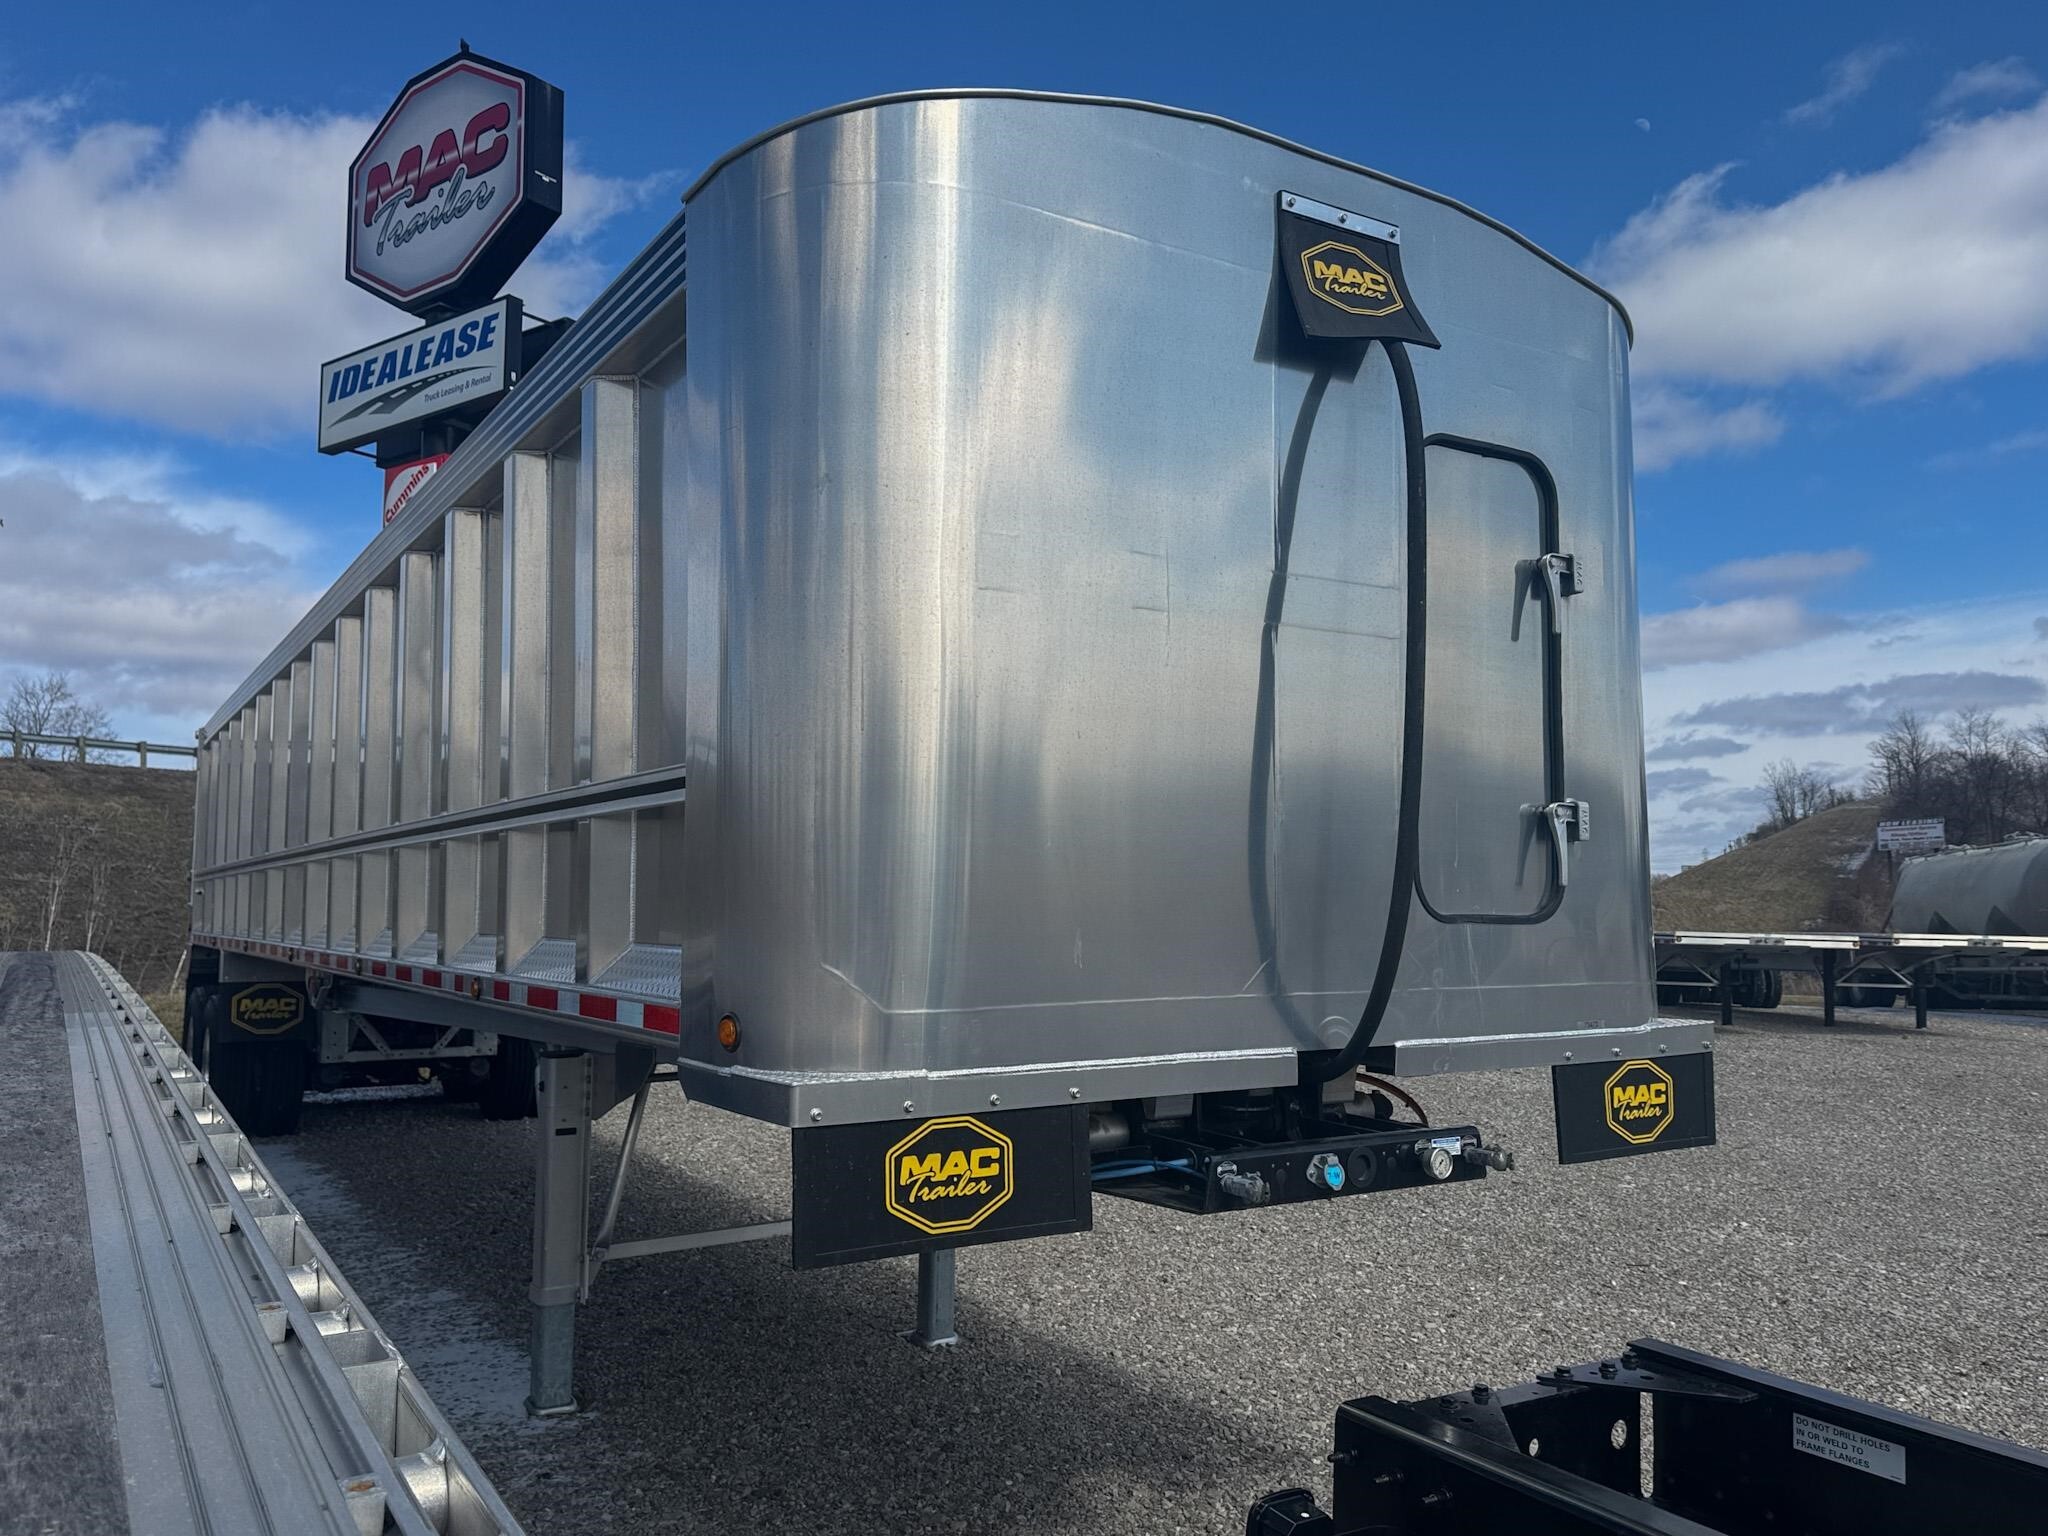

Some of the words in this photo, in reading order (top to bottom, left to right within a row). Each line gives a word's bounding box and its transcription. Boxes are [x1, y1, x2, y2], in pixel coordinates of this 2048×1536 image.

[364, 102, 510, 228] MAC
[374, 167, 496, 256] Trailer
[1313, 259, 1388, 293] MAC
[1319, 274, 1386, 300] Trailer
[327, 312, 500, 404] IDEALEASE
[424, 390, 440, 403] Truck
[441, 383, 464, 397] Leasing
[465, 380, 470, 389] &
[471, 371, 492, 387] Rental
[385, 464, 430, 523] Cummins
[240, 998, 298, 1012] MAC
[1613, 1082, 1667, 1108] MAC
[1618, 1100, 1663, 1121] Trailer
[900, 1147, 1001, 1186] MAC
[906, 1169, 992, 1203] Trailer
[1795, 1416, 1809, 1427] DO
[1811, 1421, 1830, 1434] NOT
[1833, 1428, 1858, 1442] DRILL
[1860, 1436, 1891, 1453] HOLES
[1796, 1428, 1805, 1437] IN
[1807, 1431, 1820, 1442] OR
[1822, 1436, 1848, 1450] WELD
[1851, 1444, 1864, 1456] TO
[1796, 1438, 1826, 1455] FRAME
[1829, 1448, 1870, 1469] FLANGES
